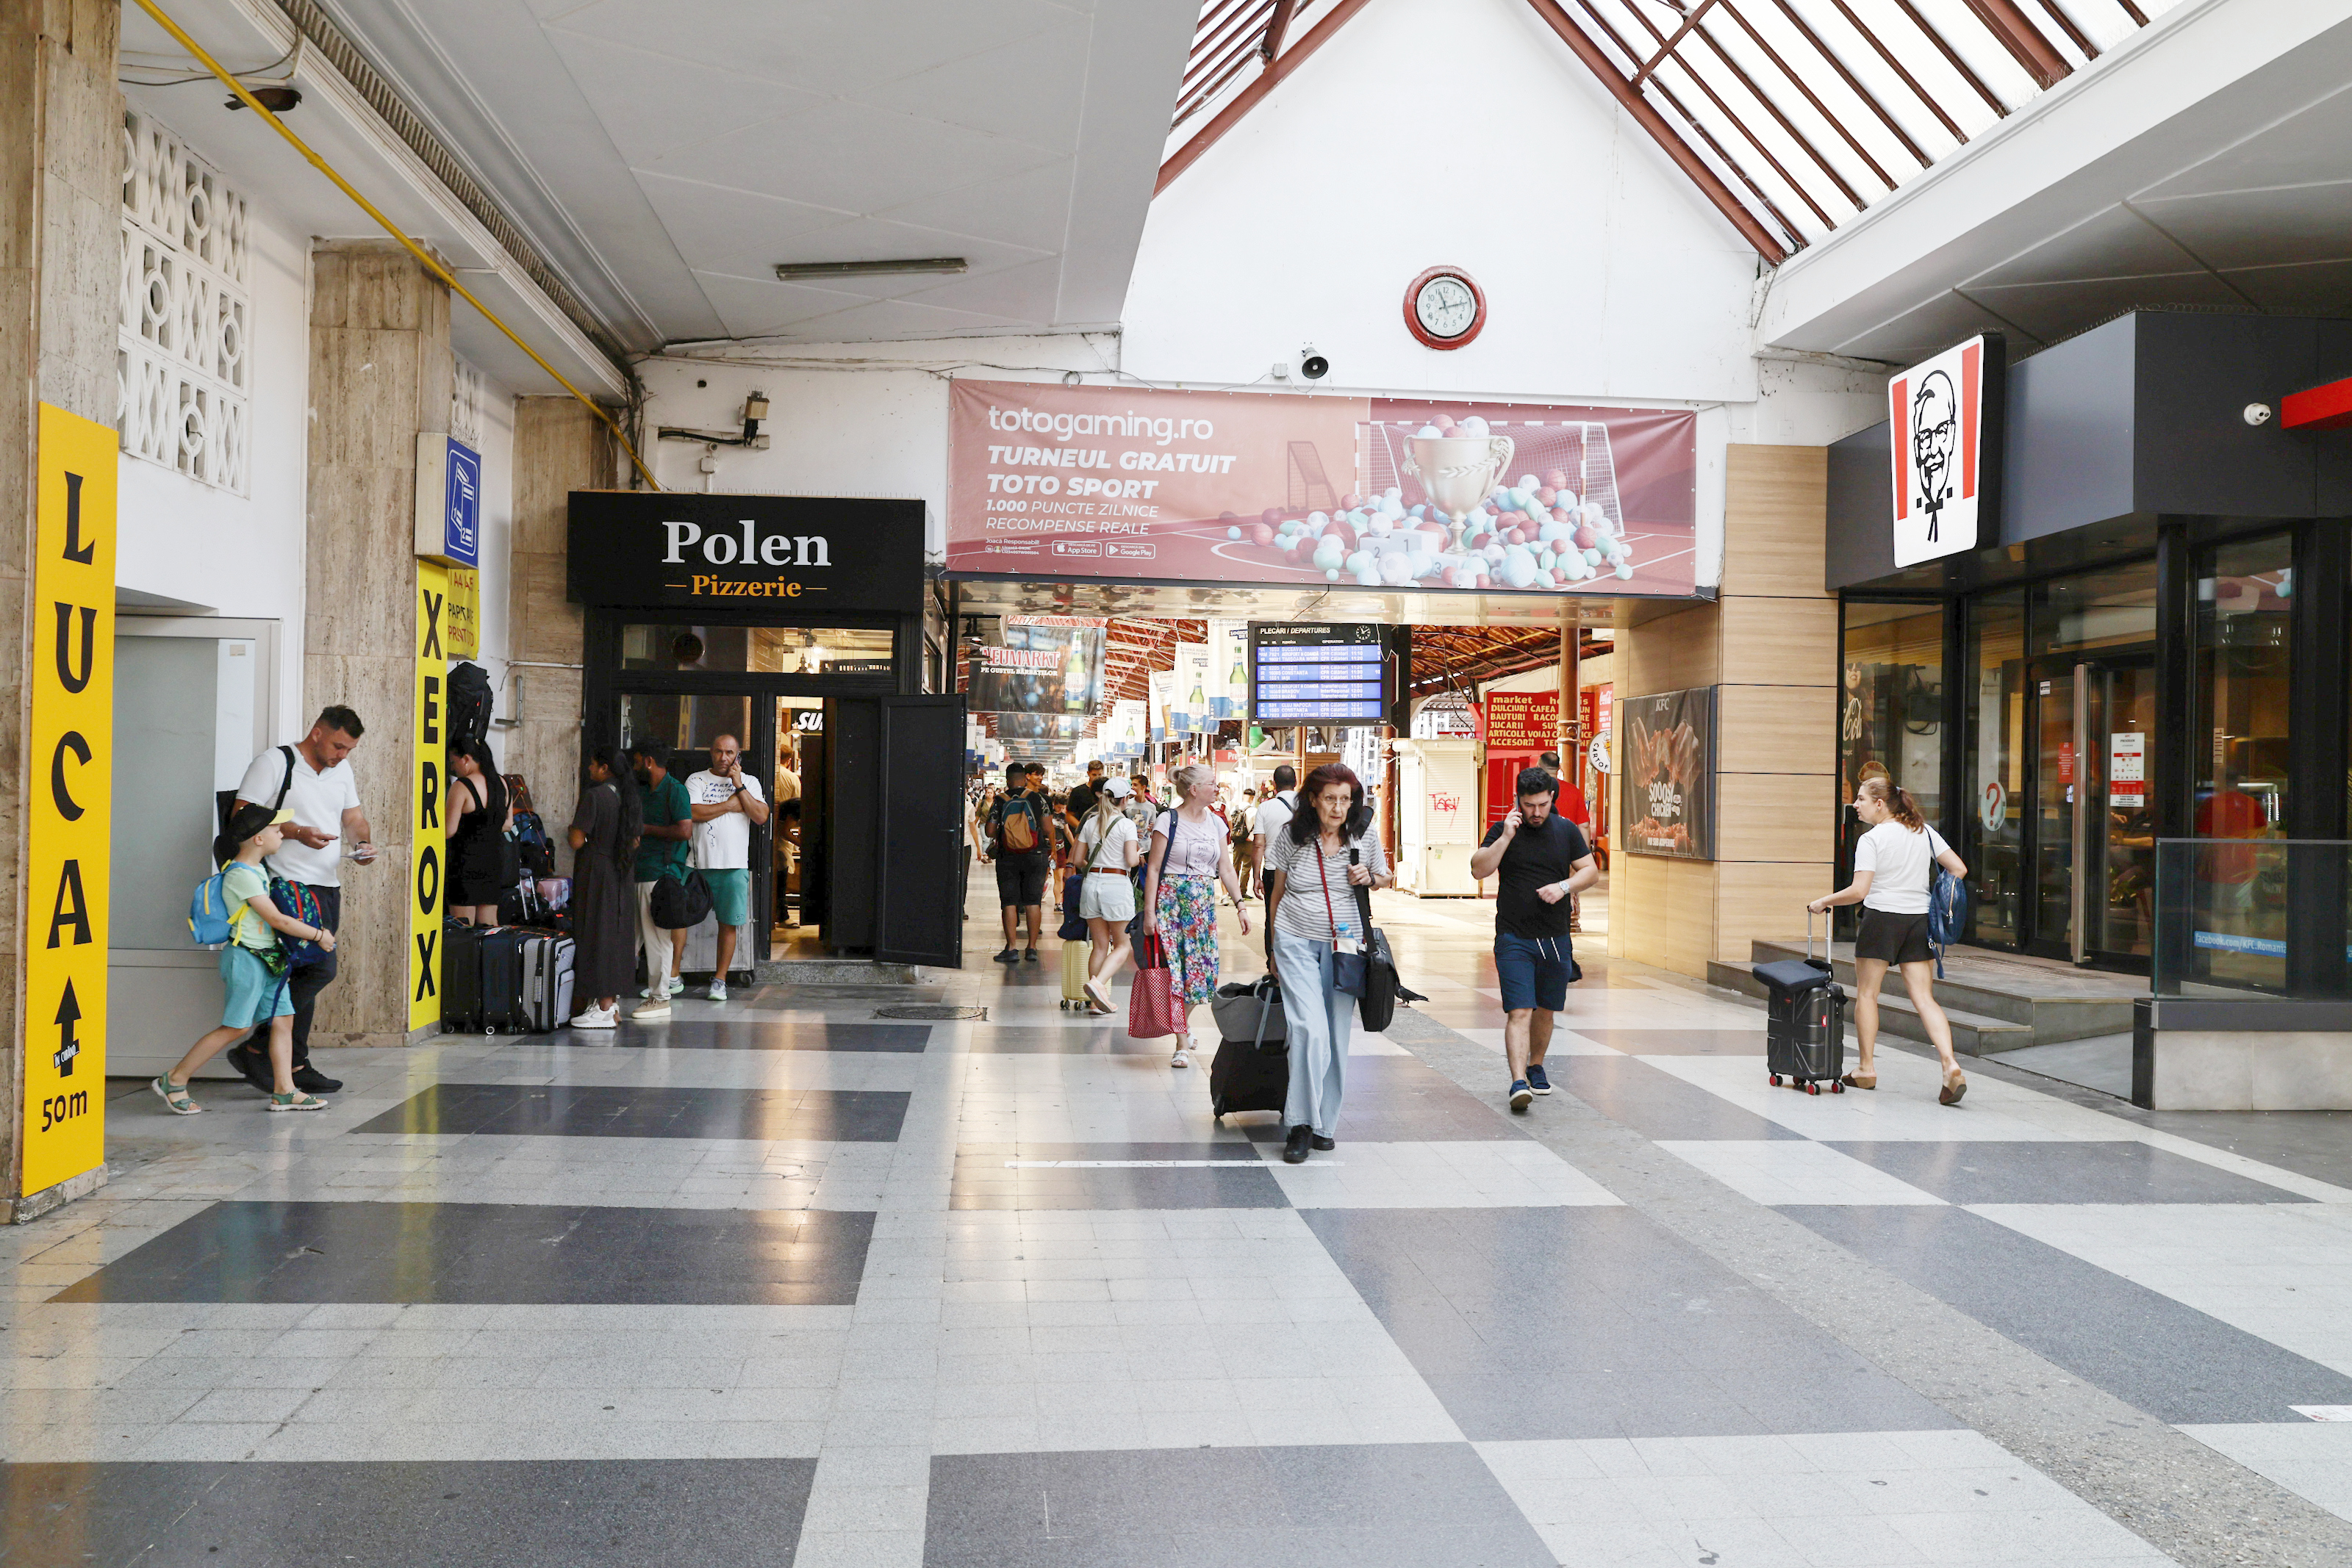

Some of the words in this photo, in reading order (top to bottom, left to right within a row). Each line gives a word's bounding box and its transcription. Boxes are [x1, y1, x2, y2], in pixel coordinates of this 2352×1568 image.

[989, 406, 1213, 446] totogaming.ro
[988, 445, 1111, 469] TURNEUL
[1119, 451, 1236, 474] GRATUIT
[987, 474, 1060, 495] TOTO
[1066, 477, 1158, 499] SPORT
[986, 499, 1028, 512] 1.000
[1031, 502, 1094, 515] PUNCTE
[1097, 503, 1159, 517] ZILNICE
[986, 518, 1096, 533] RECOMPENSE
[1100, 522, 1149, 535] REALE
[662, 519, 831, 567] Polen
[1374, 547, 1380, 558] 2
[1404, 539, 1408, 552] 1
[1435, 561, 1441, 575] 3
[691, 575, 801, 597] Pizzerie
[979, 647, 1061, 668] NEUMARKT
[47, 470, 96, 949] LUCA
[1494, 696, 1532, 704] market
[1655, 698, 1669, 711] KFC
[792, 711, 823, 730] SU
[415, 589, 442, 1001] XEROX
[1652, 802, 1671, 817] CHICKEN
